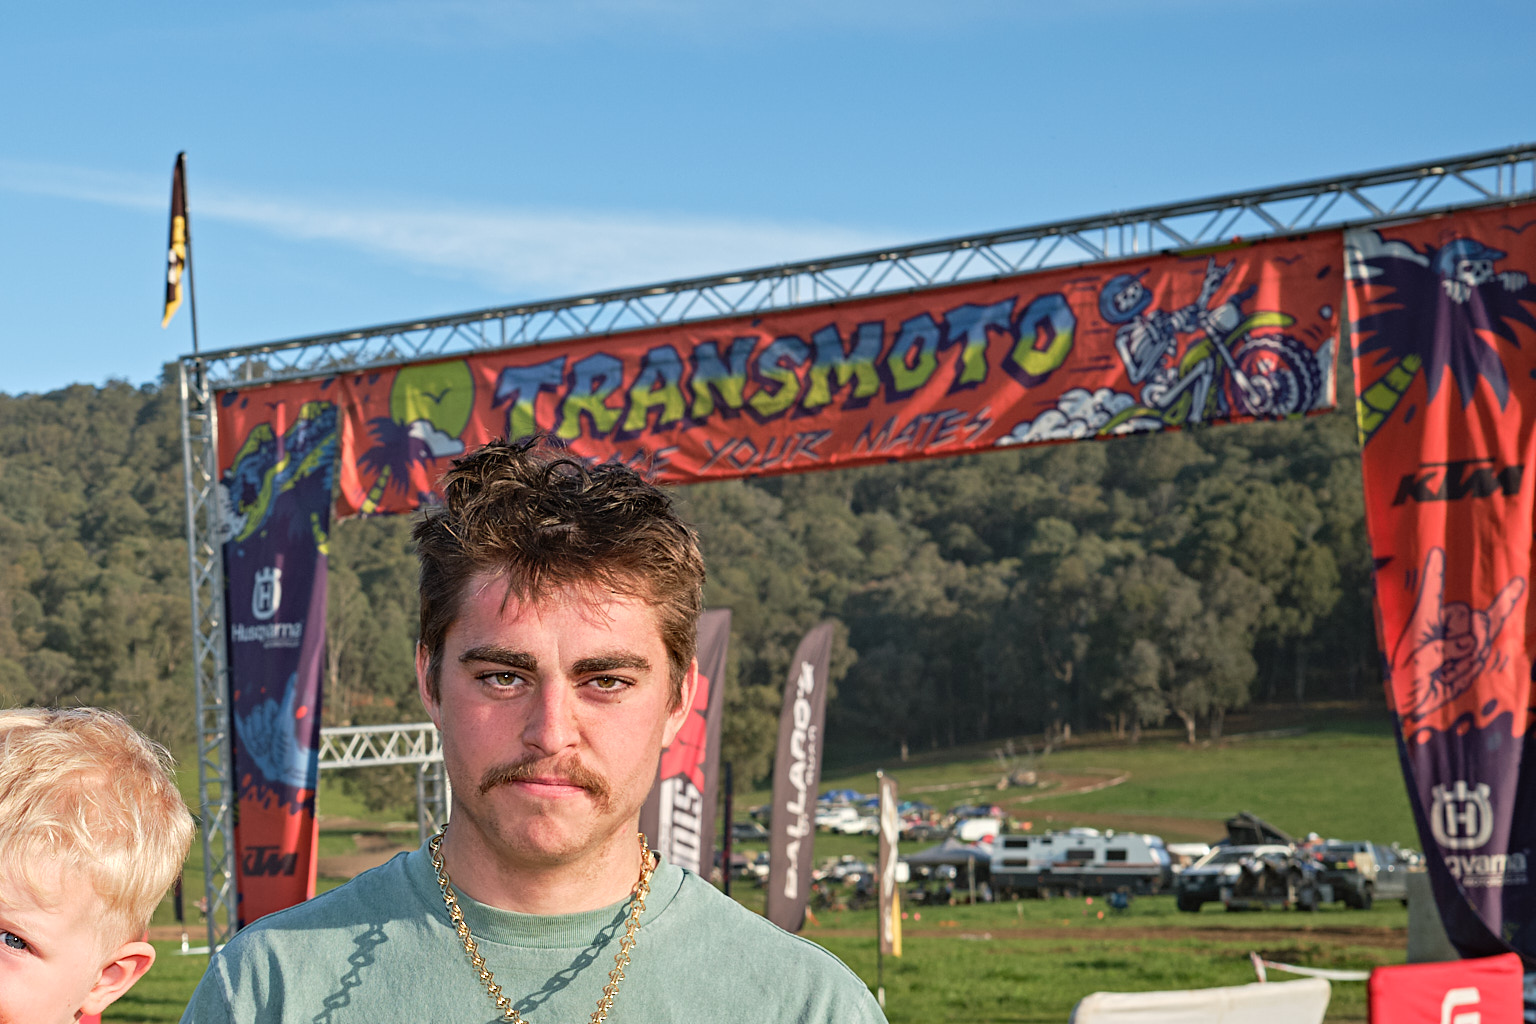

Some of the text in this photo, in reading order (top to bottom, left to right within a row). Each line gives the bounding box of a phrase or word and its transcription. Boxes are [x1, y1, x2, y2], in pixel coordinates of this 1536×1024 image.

[492, 292, 1076, 442] TRANSMOTO
[697, 429, 832, 476] YOUR
[852, 406, 995, 456] MATES
[1392, 457, 1525, 506] KTM
